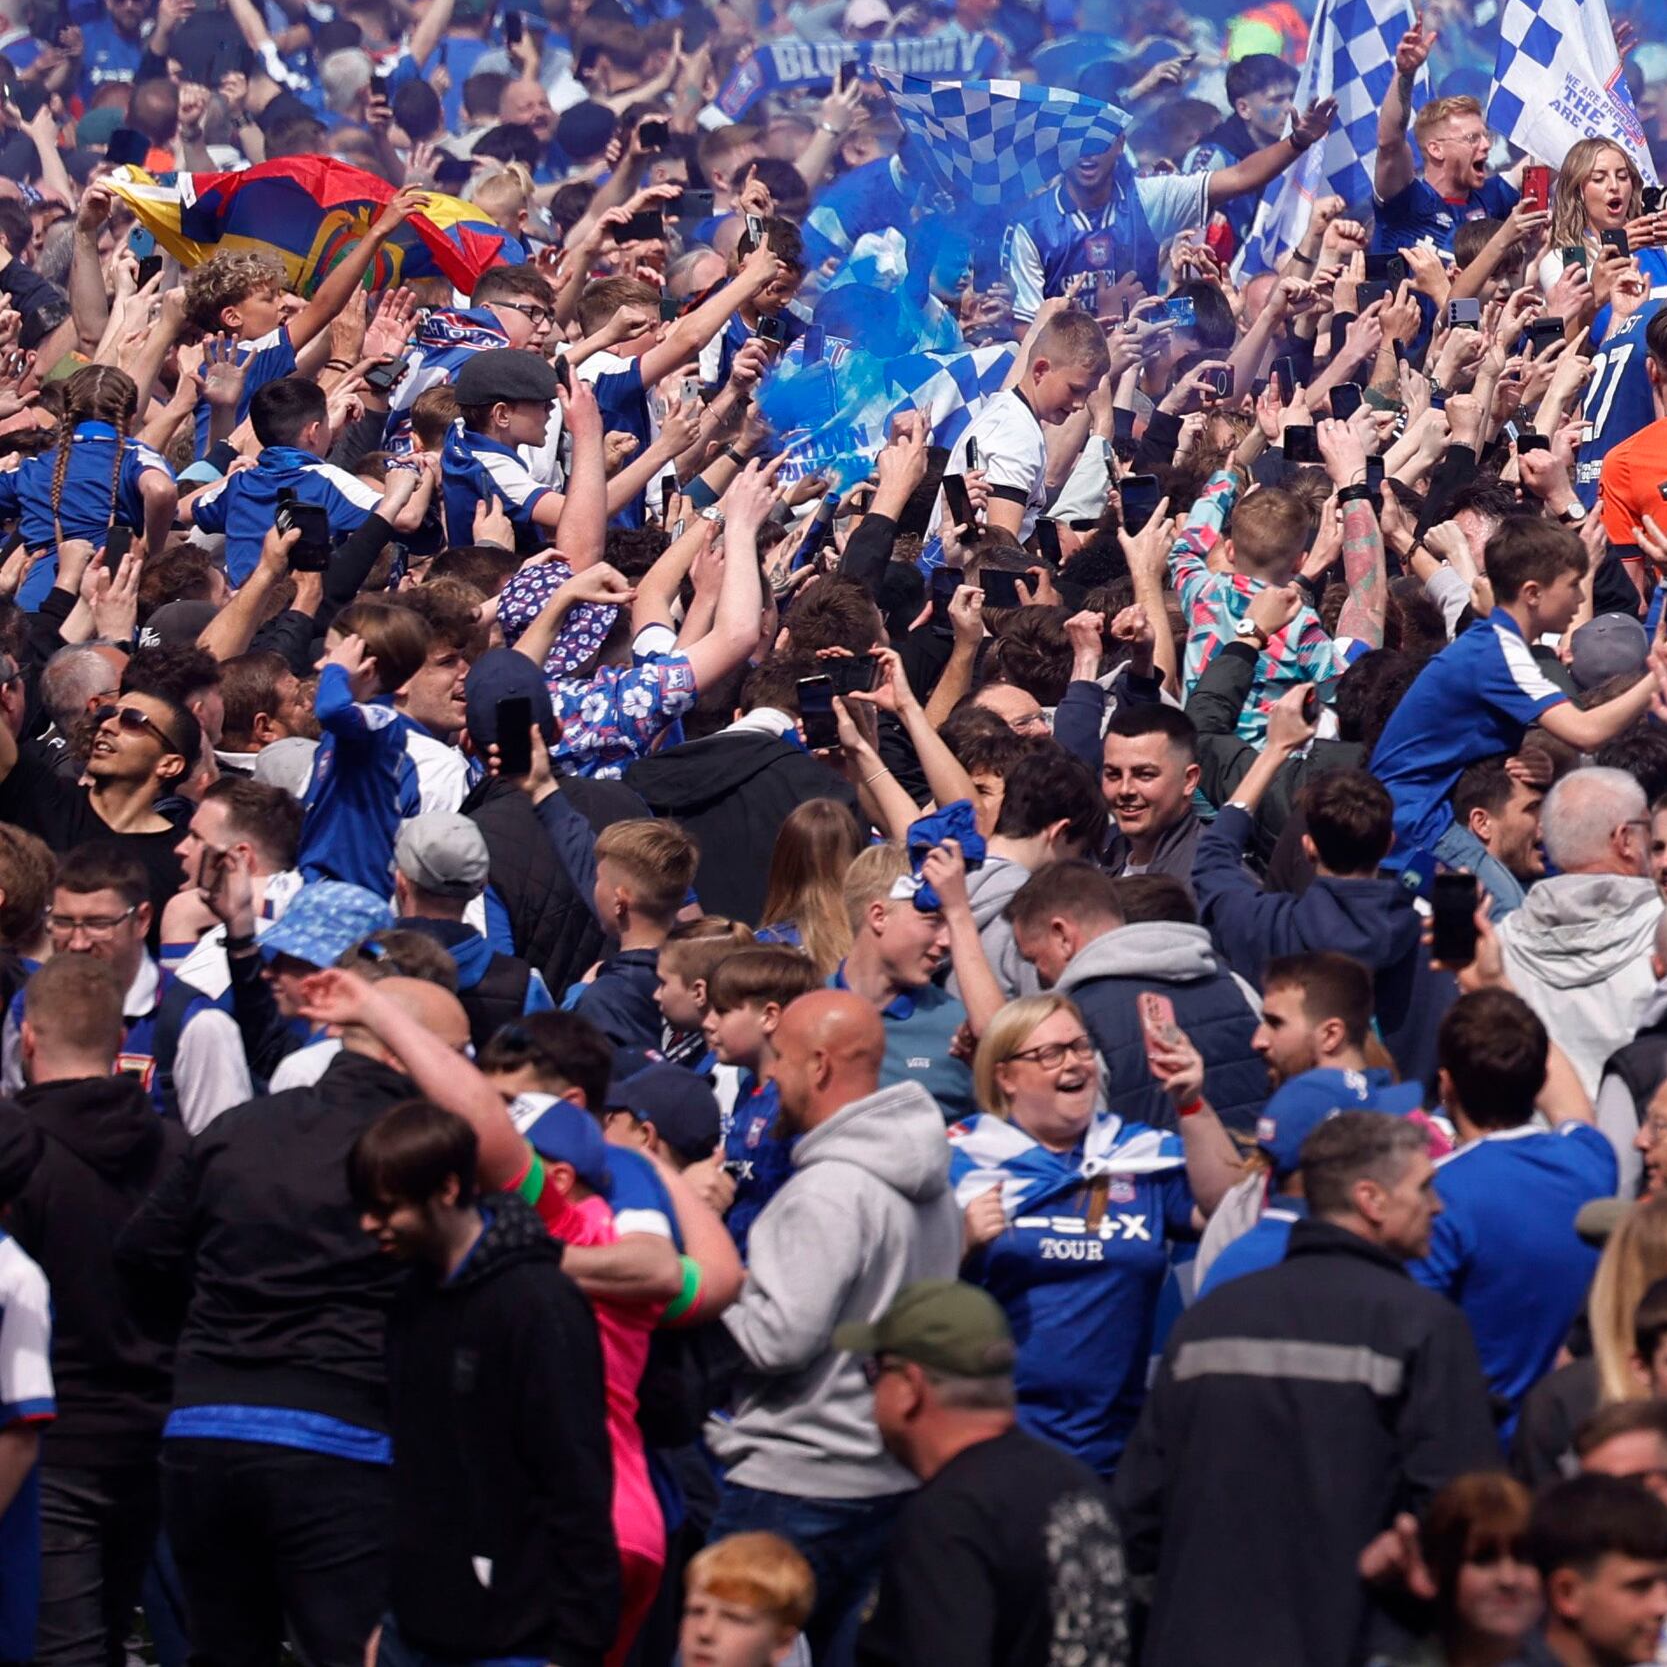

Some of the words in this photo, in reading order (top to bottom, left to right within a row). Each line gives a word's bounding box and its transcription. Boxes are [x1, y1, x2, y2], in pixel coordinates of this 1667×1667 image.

[870, 34, 983, 75] ARMY
[1564, 71, 1581, 90] WE
[1580, 86, 1602, 105] ARE
[1548, 97, 1583, 128] ARE
[1563, 85, 1606, 126] THE
[1038, 1237, 1105, 1262] TOUR
